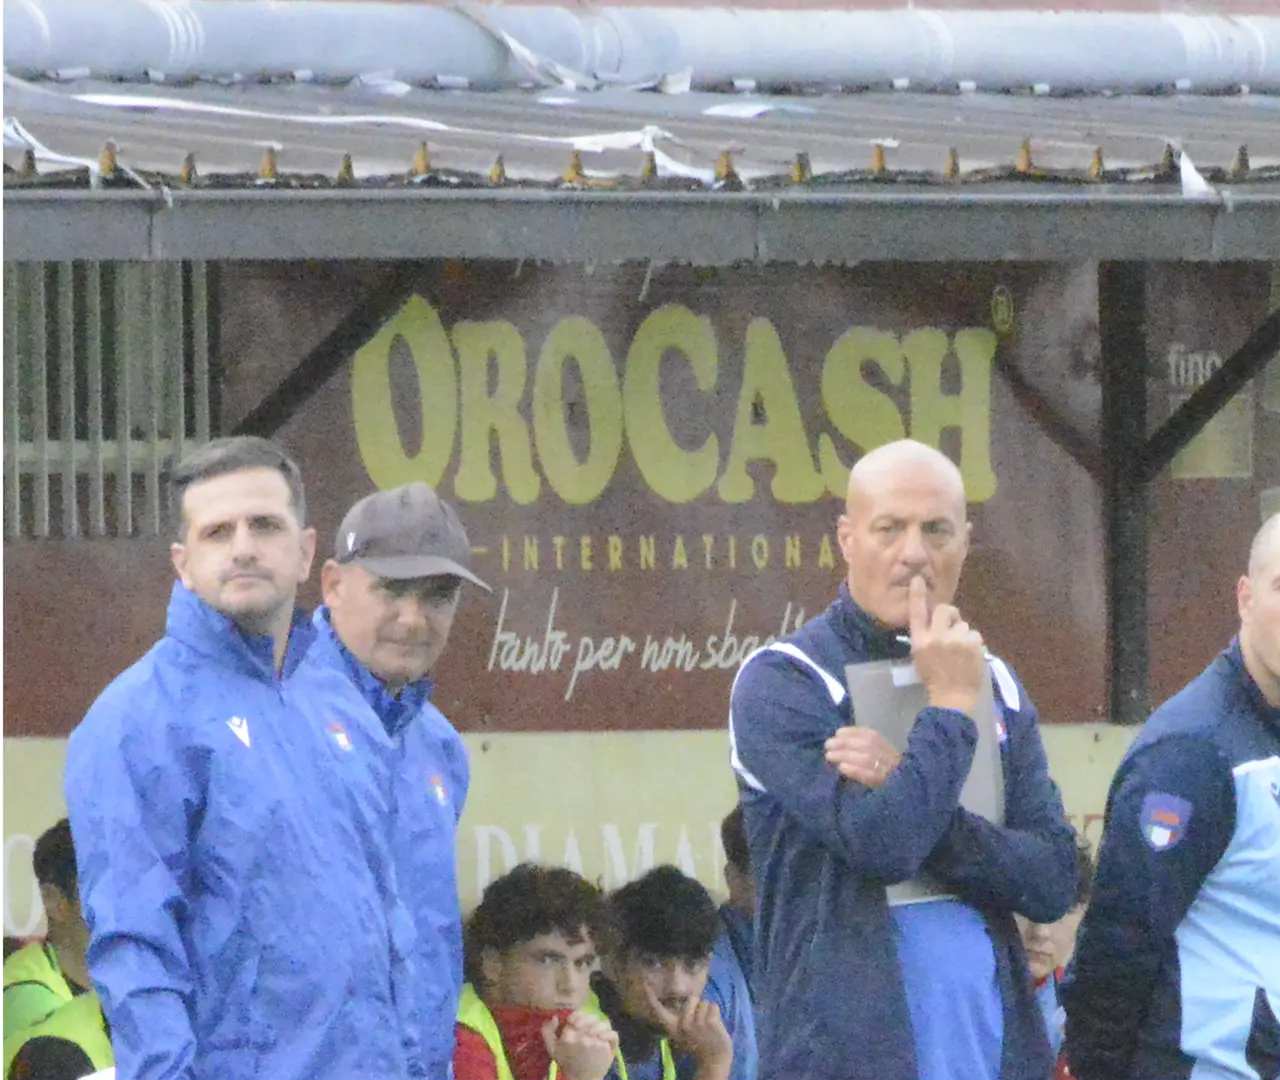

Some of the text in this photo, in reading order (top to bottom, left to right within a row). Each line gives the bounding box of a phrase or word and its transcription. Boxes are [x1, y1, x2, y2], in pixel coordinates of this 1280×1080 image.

[351, 294, 997, 505] OROCASH
[502, 534, 836, 571] INTERNATIONA
[488, 587, 571, 673] tanto
[565, 634, 636, 700] per
[640, 631, 699, 673] non
